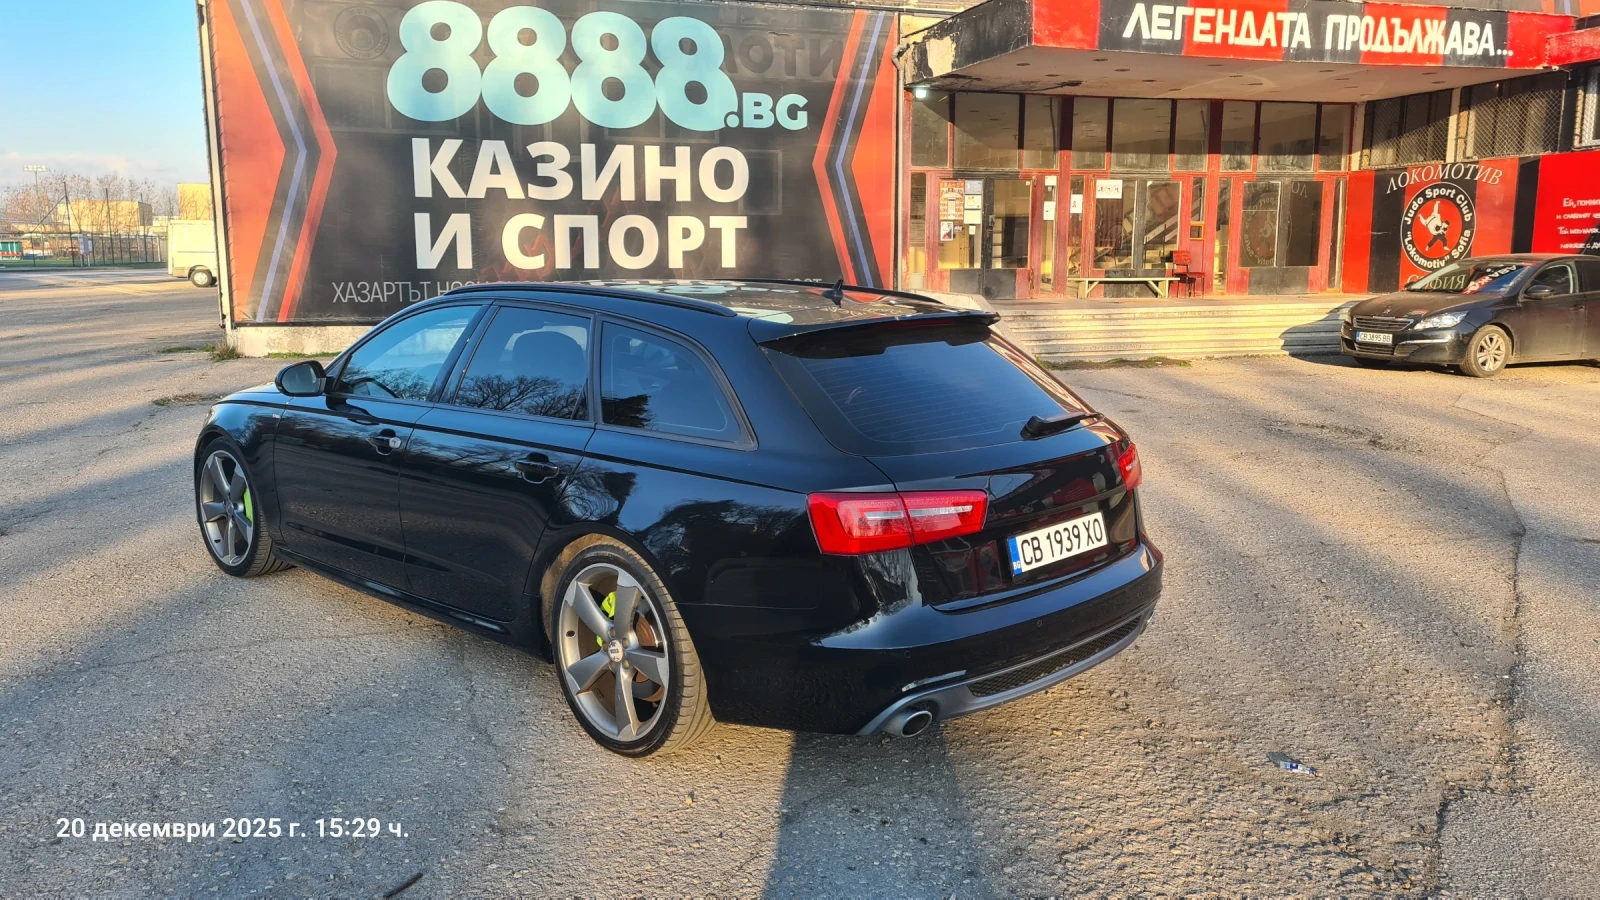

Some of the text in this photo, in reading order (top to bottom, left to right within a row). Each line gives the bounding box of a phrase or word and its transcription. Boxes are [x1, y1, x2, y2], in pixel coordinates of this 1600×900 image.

[1122, 3, 1514, 56] ЛЕГЕНДАТА ПРОДЪЛЖАВА...
[412, 138, 749, 202] КАЗИНО
[1386, 163, 1502, 194] ЛОКОМОТИВ
[1404, 188, 1473, 225] Judo Sport Club
[413, 213, 747, 270] И СПОРТ
[1451, 229, 1471, 259] Sofia
[332, 281, 431, 303] ХАЗАРТЪТ
[1406, 274, 1467, 289] СФИЯ
[1021, 518, 1103, 566] CB 1939 XO
